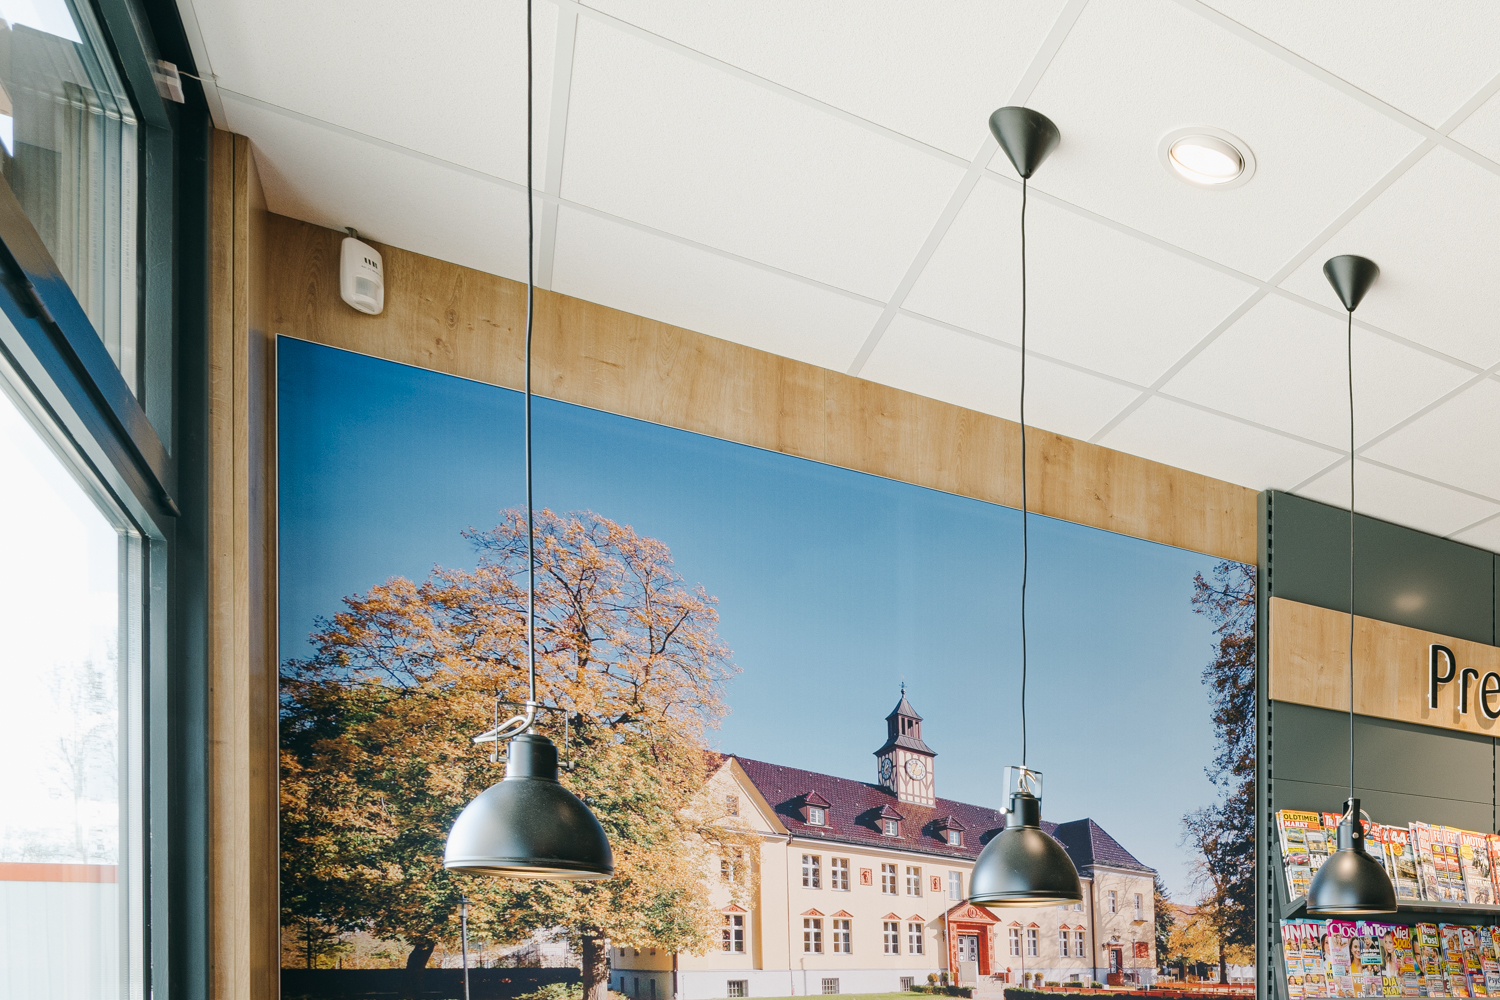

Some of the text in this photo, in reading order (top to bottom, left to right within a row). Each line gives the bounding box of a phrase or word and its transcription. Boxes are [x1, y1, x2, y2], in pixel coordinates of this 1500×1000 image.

[1283, 813, 1319, 822] OLDTIMER
[1301, 924, 1318, 939] IN
[1329, 923, 1357, 937] Clos
[1393, 927, 1409, 939] Viel
[1421, 926, 1436, 935] Neue
[1393, 936, 1412, 948] Spaß
[1422, 935, 1438, 944] Post
